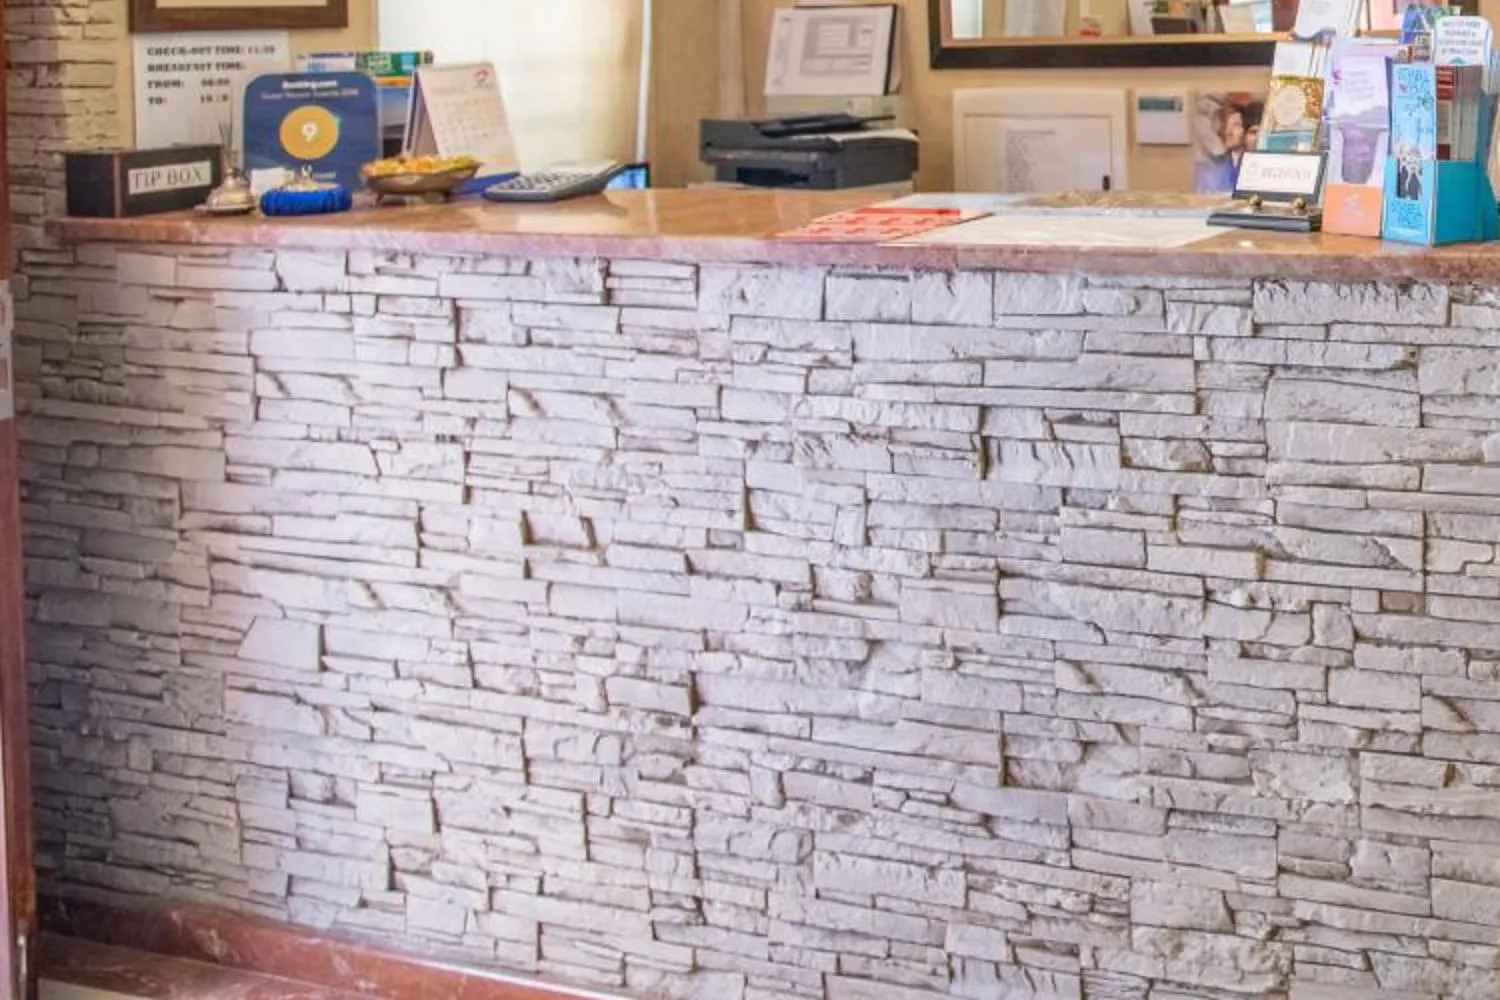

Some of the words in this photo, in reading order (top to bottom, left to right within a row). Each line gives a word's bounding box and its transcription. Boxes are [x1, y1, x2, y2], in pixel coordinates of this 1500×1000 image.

[146, 46, 212, 56] CHECK-OUT
[146, 79, 184, 89] FROM:
[301, 120, 319, 143] 9
[132, 168, 162, 191] TIP
[166, 165, 205, 186] BOX
